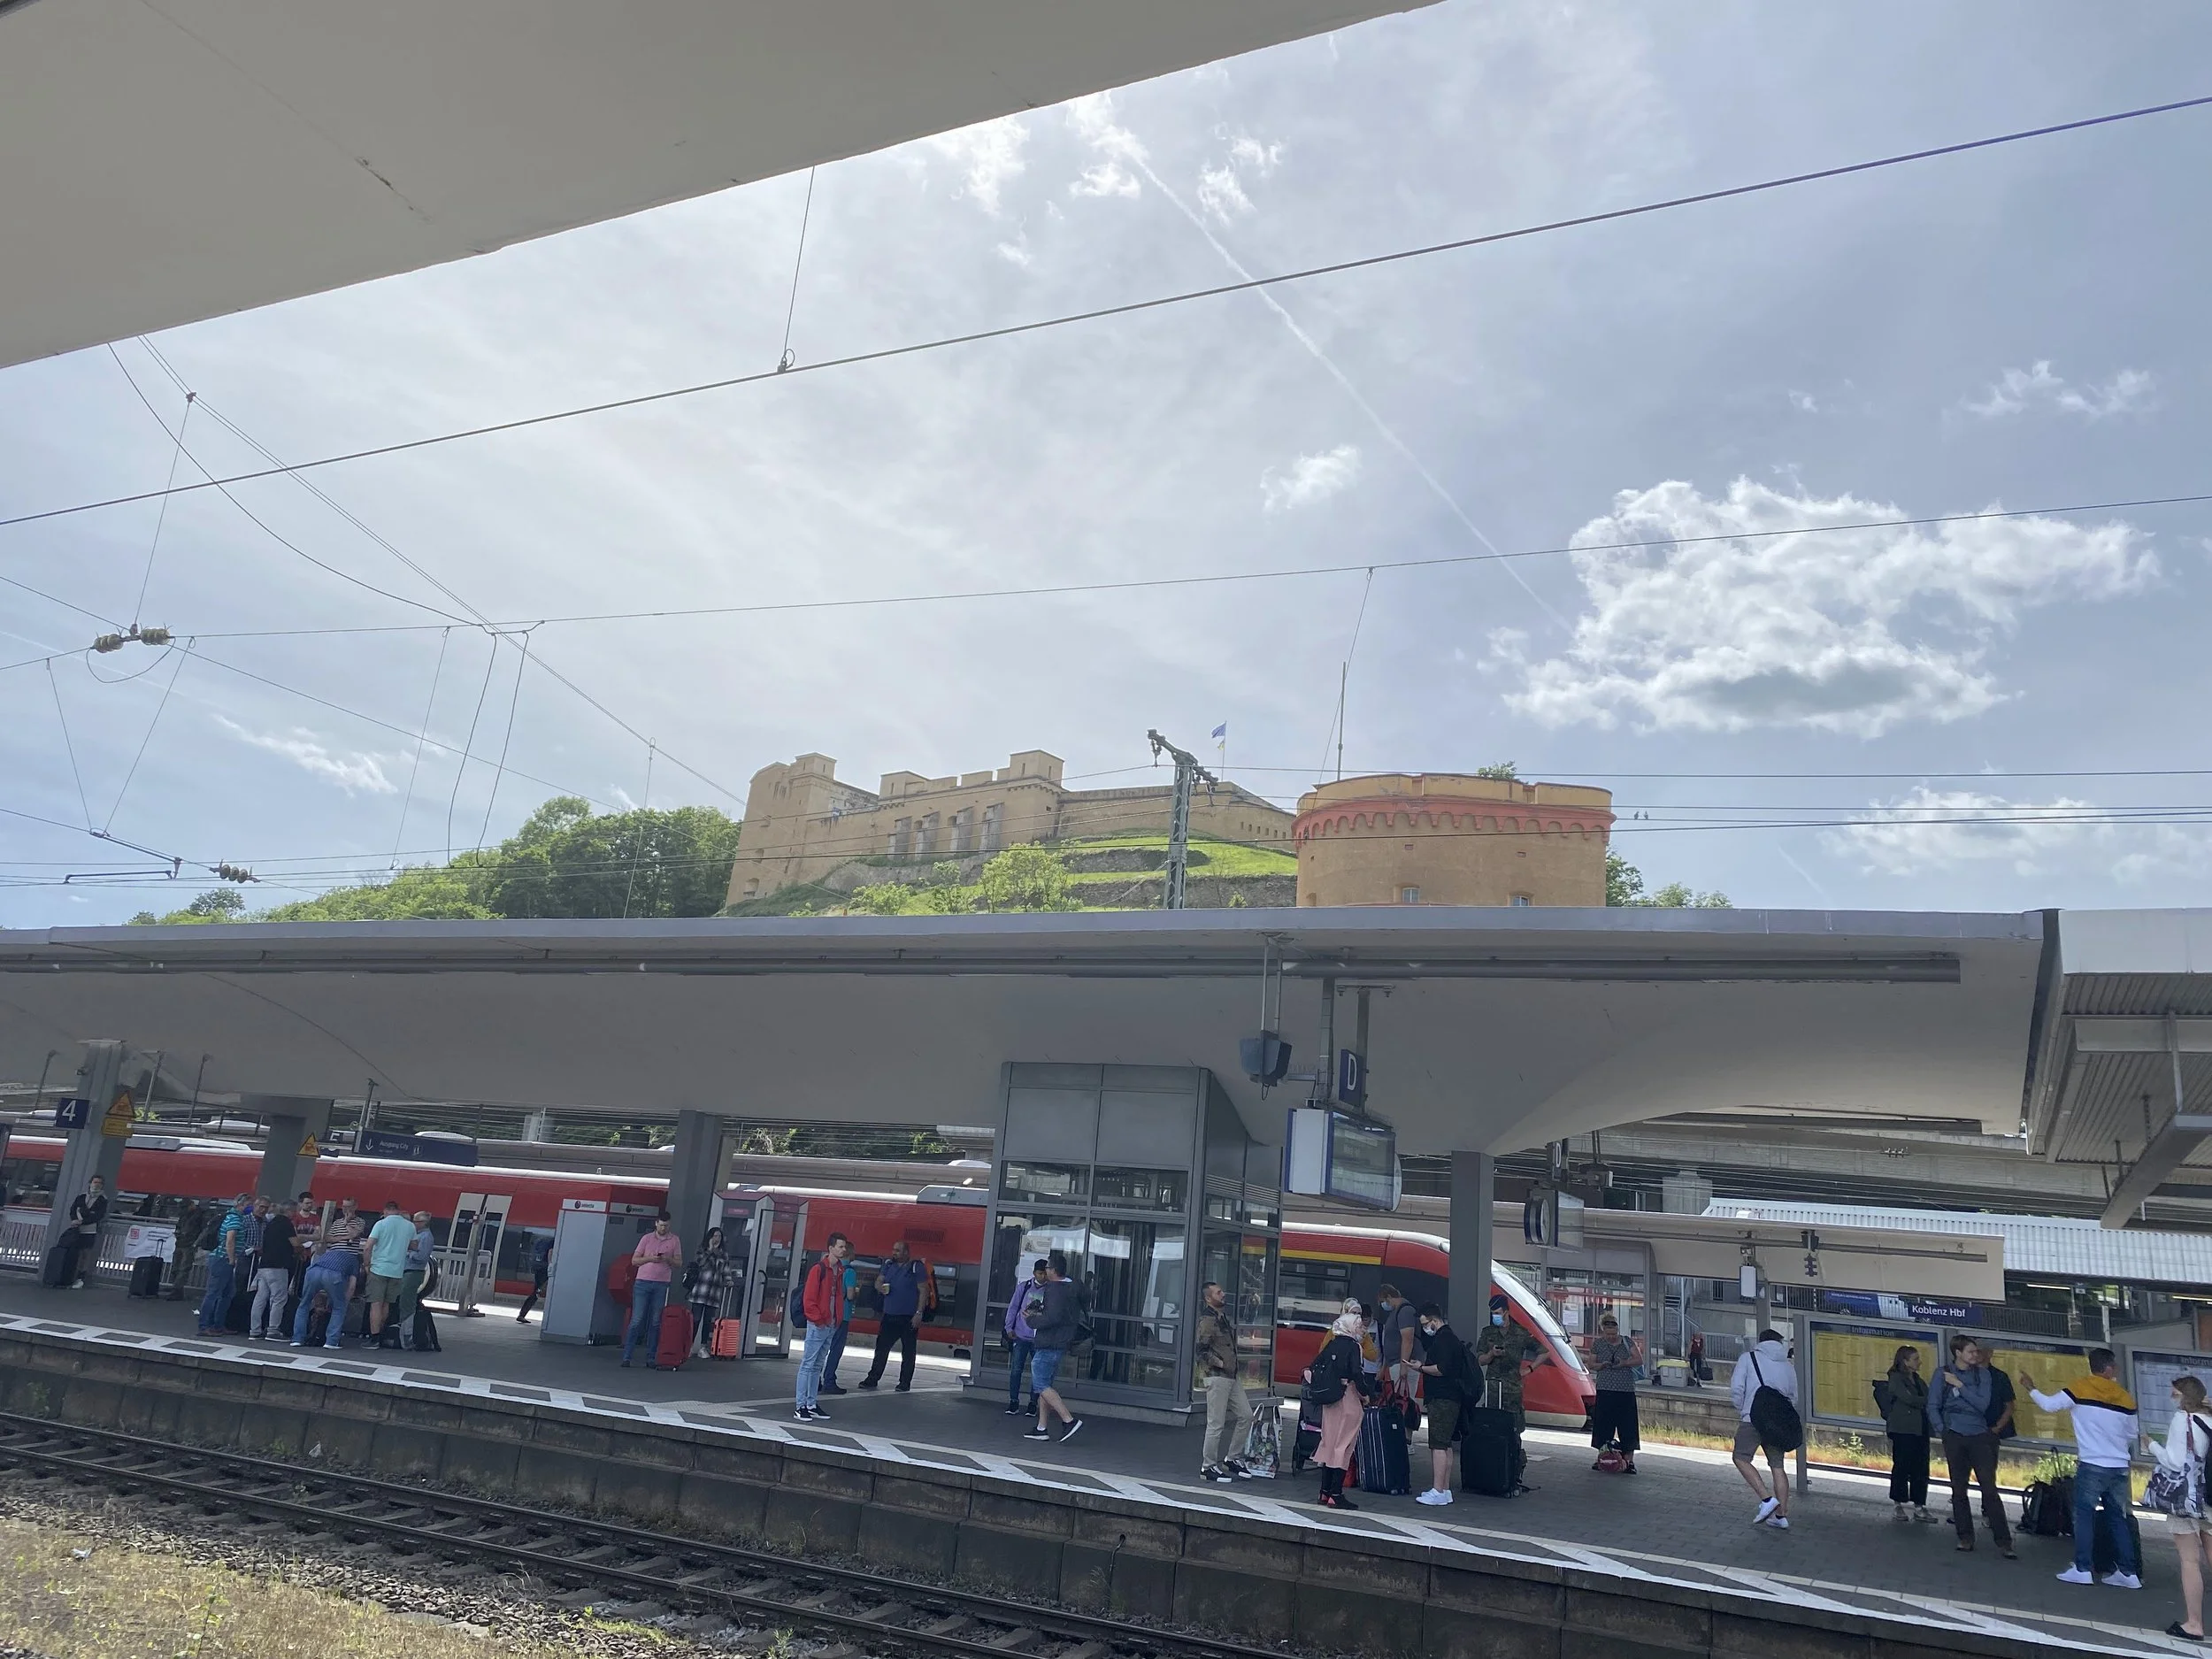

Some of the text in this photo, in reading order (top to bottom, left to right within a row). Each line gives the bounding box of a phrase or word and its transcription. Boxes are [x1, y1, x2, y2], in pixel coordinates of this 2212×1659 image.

[1347, 1053, 1357, 1091] D
[61, 1100, 77, 1122] 4
[1555, 1141, 1562, 1168] D
[1911, 1305, 1966, 1317] Koblenz Hbf
[1851, 1327, 1894, 1337] Information
[2010, 1341, 2056, 1351] Information
